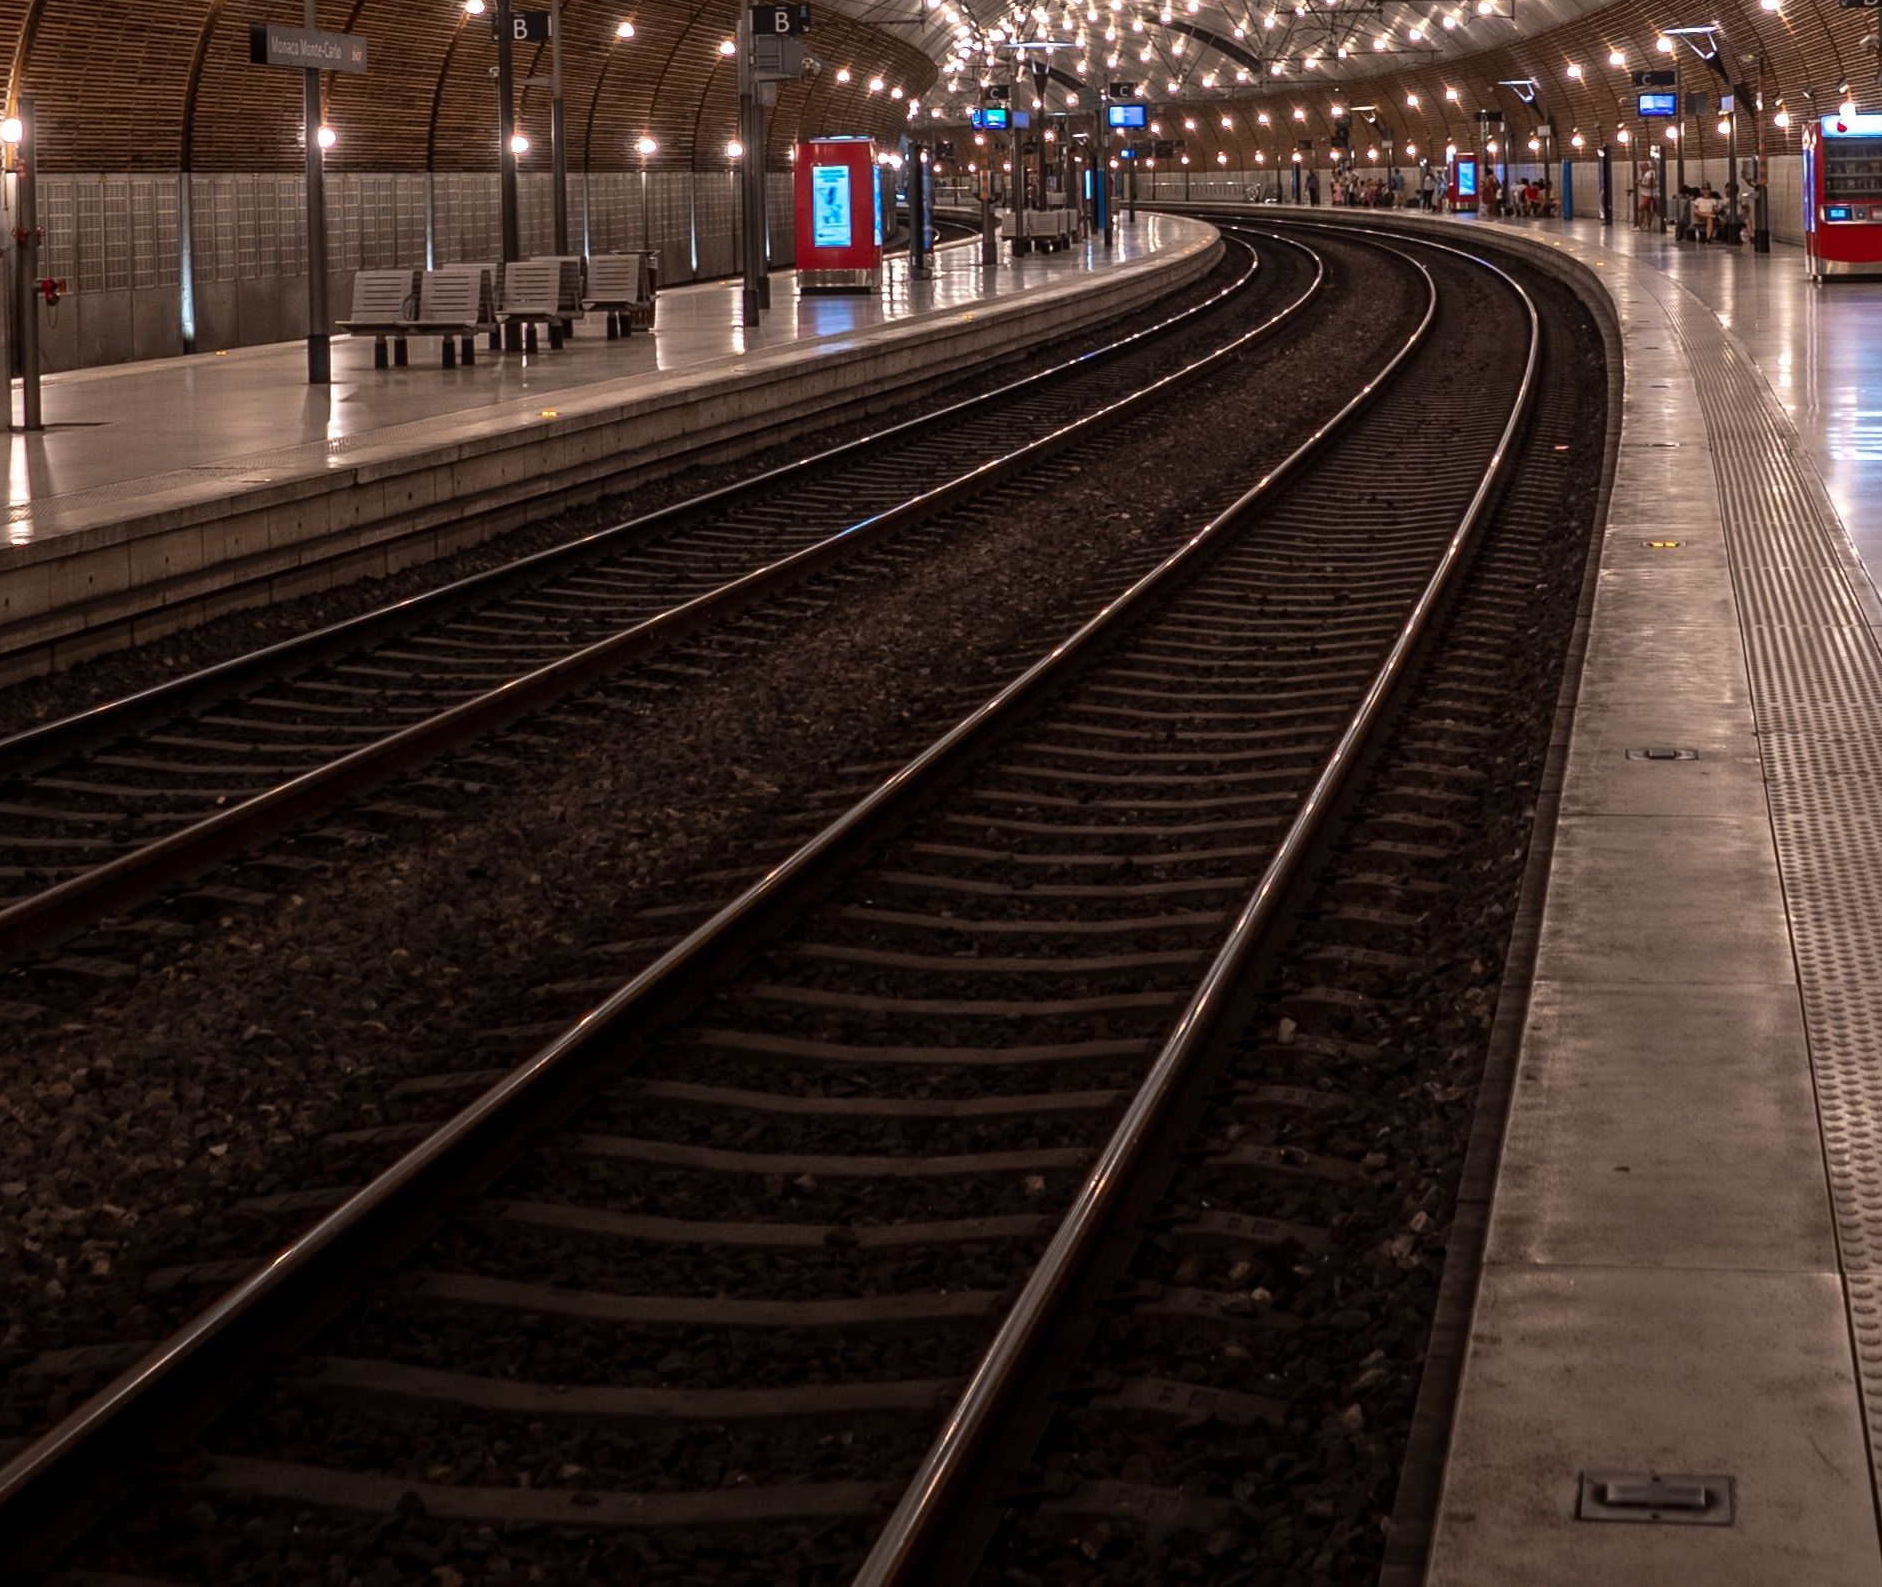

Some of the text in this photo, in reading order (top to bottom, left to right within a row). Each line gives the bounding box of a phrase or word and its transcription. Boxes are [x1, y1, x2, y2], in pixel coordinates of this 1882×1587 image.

[513, 19, 528, 39] B
[775, 12, 790, 32] B
[271, 36, 299, 56] Monaco
[1641, 74, 1652, 86] C
[989, 88, 1000, 99] C
[1119, 86, 1129, 97] C
